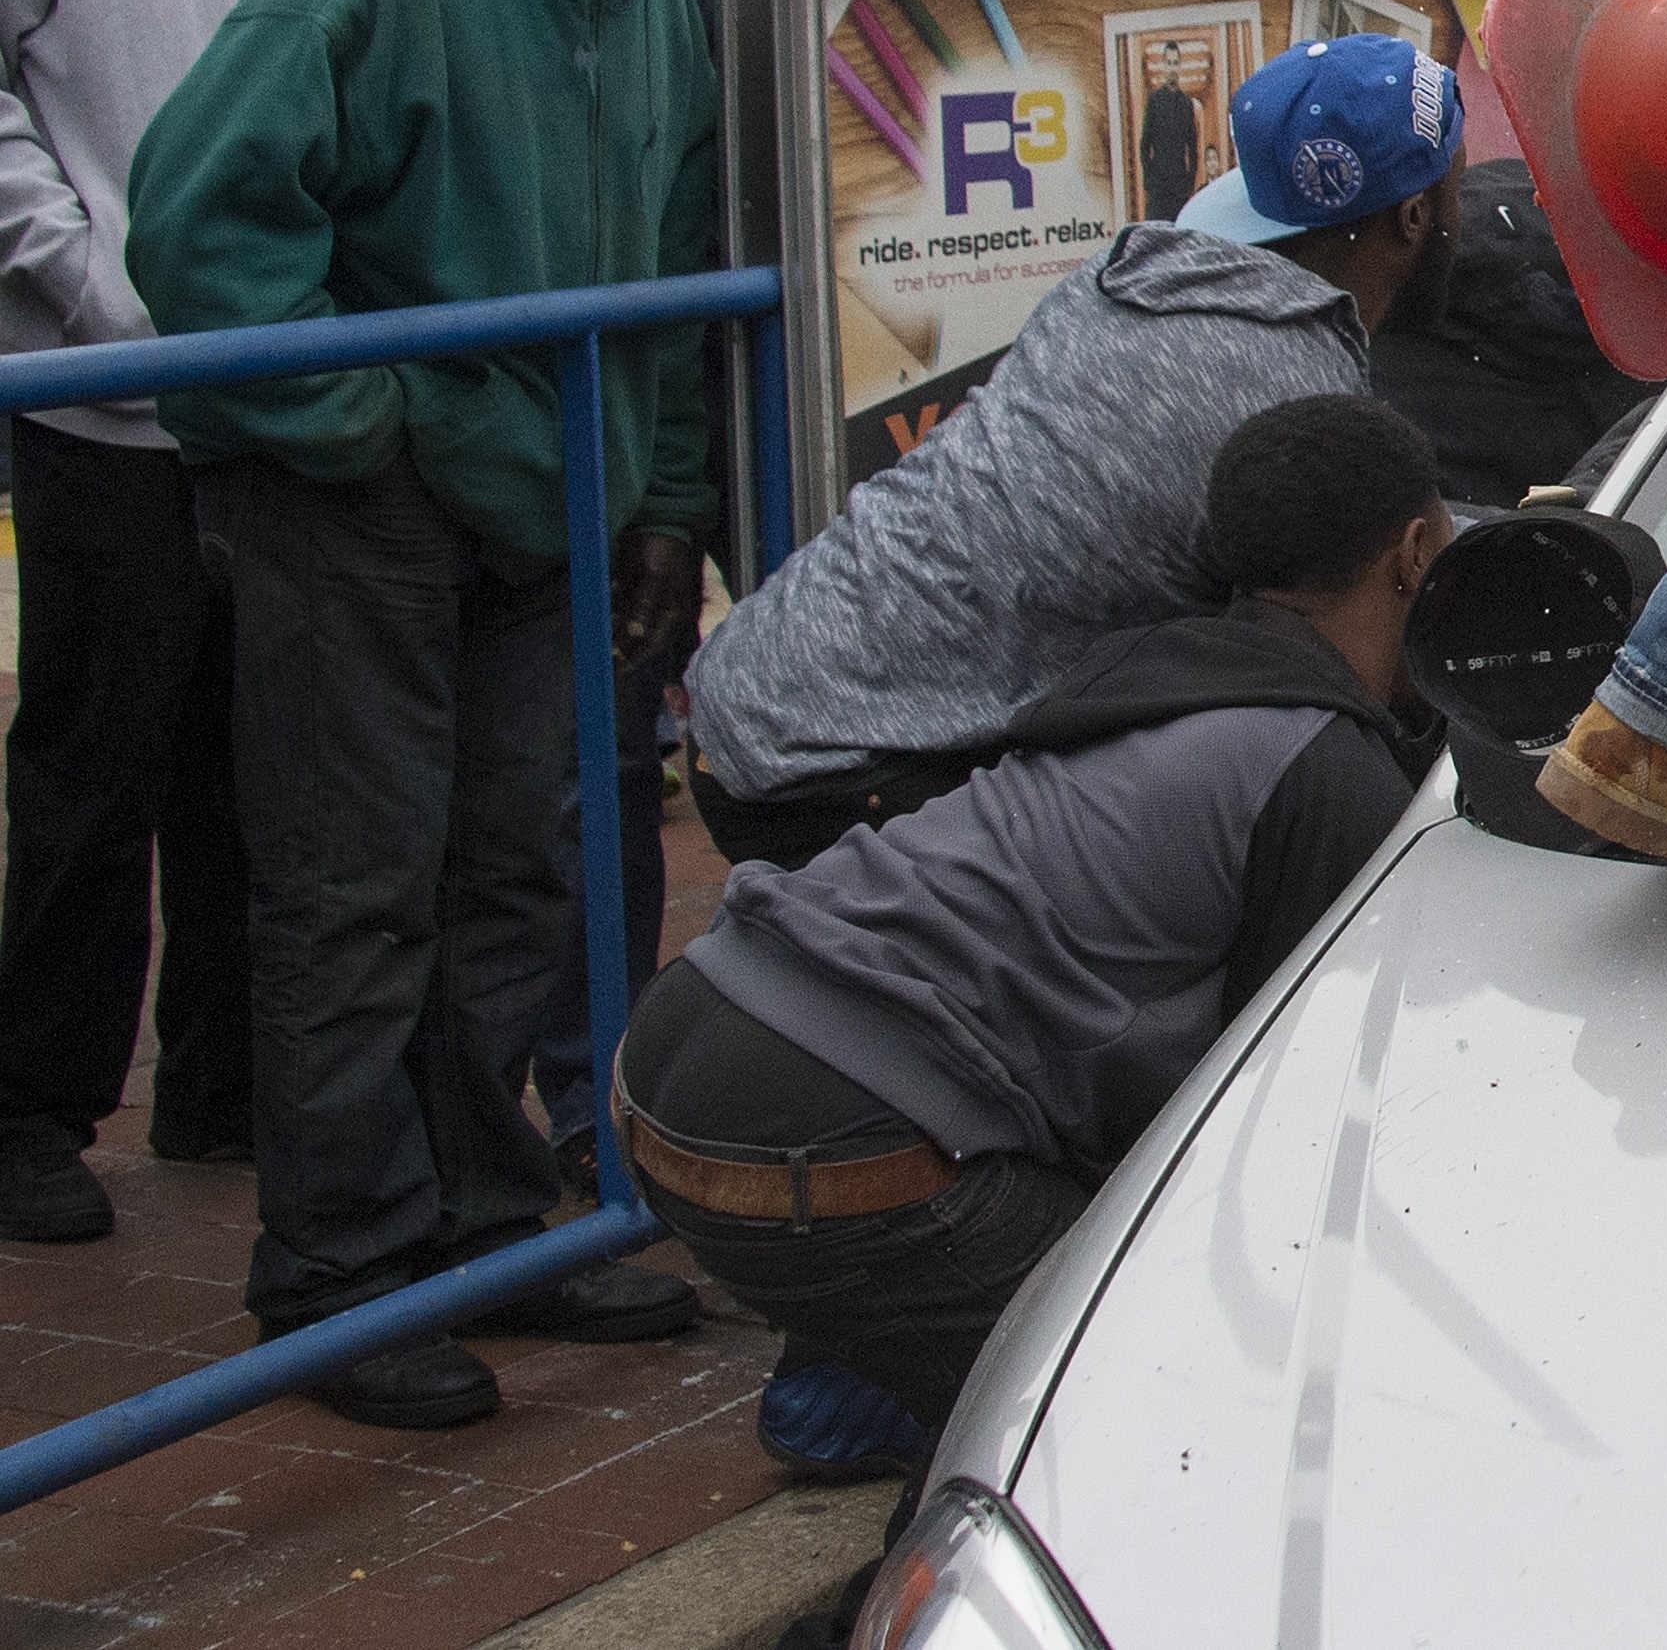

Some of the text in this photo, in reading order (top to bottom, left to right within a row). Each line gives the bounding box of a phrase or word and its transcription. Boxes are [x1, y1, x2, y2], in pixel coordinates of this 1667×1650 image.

[859, 218, 1112, 266] ride. respect. relax.
[894, 277, 923, 293] the
[926, 266, 991, 288] formula
[992, 260, 1019, 281] for
